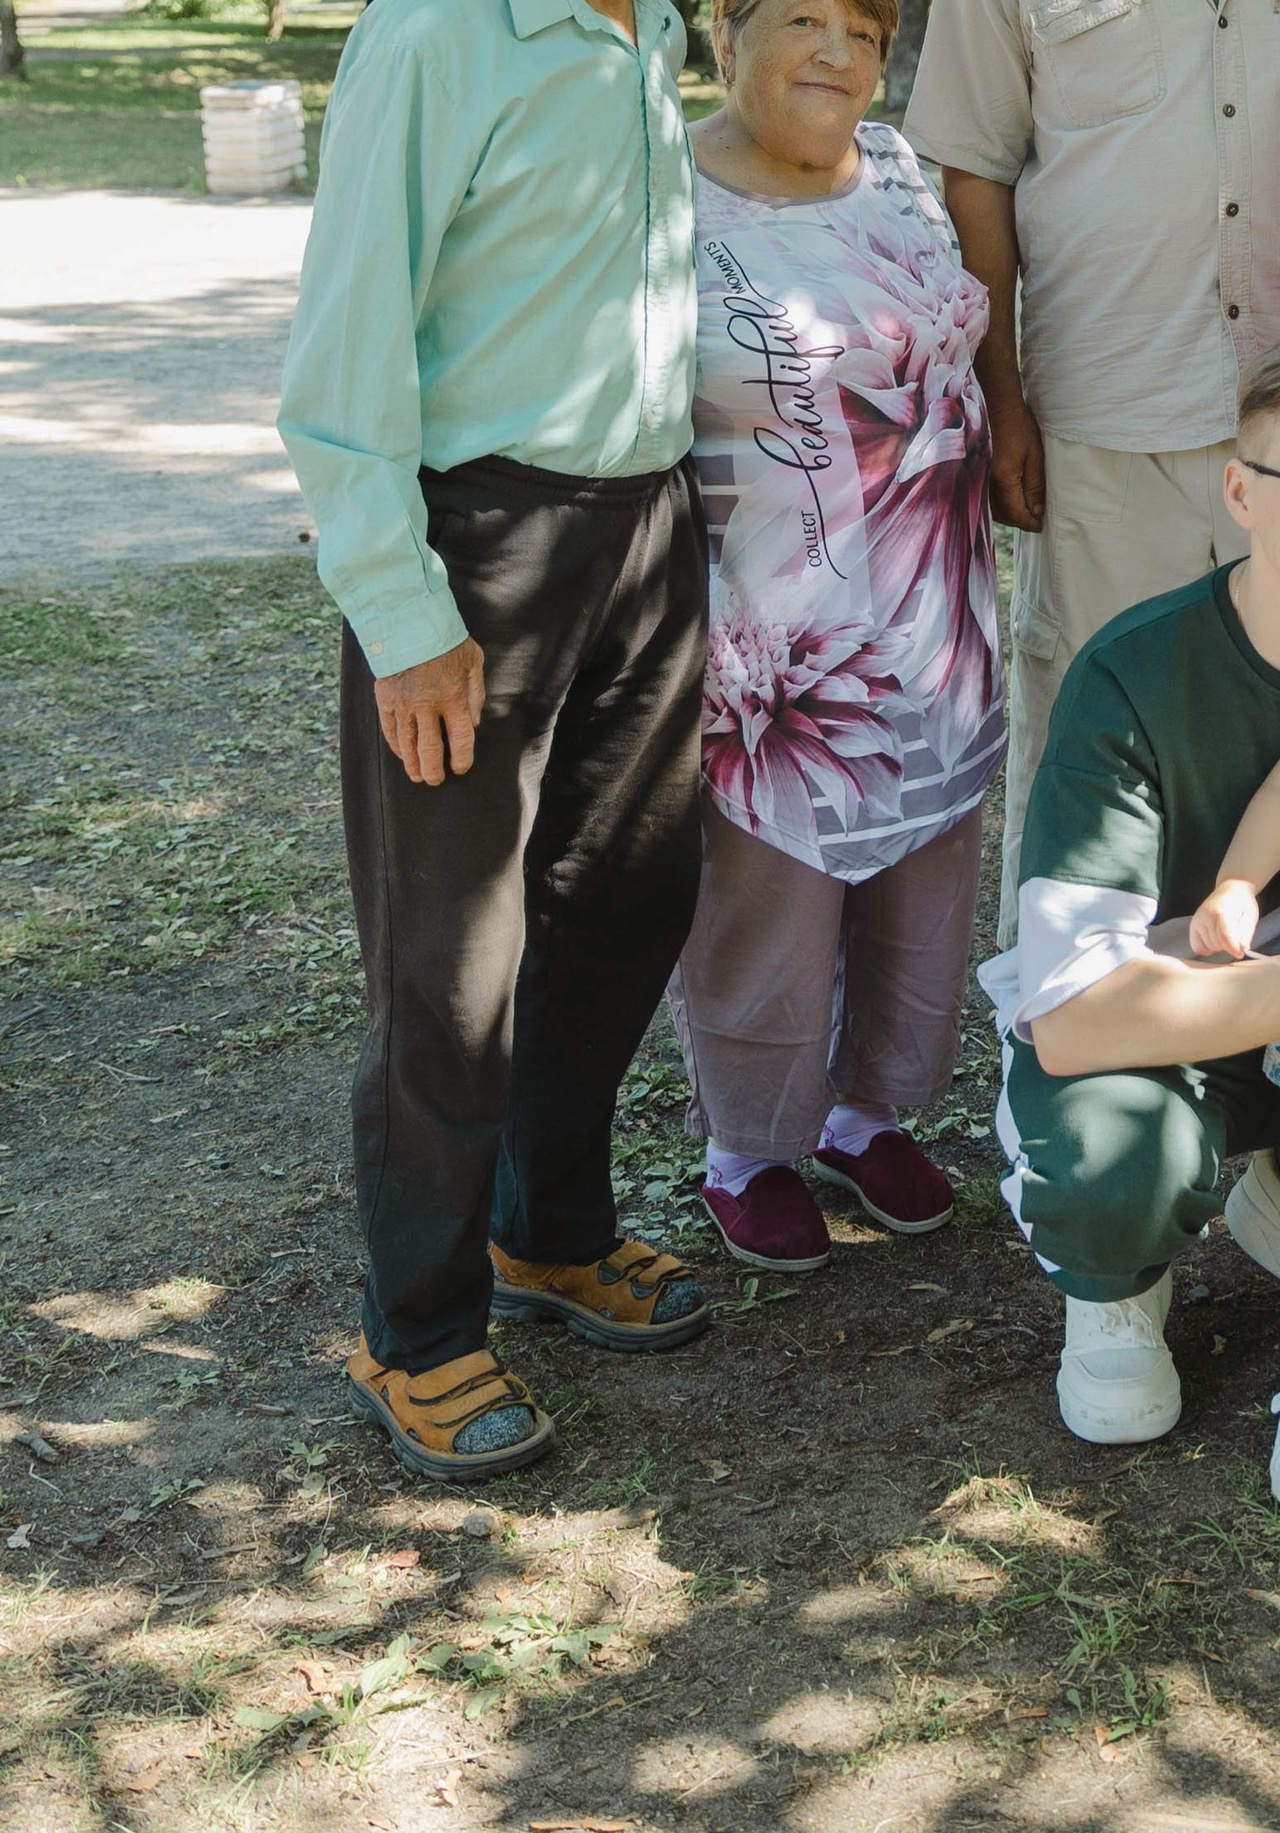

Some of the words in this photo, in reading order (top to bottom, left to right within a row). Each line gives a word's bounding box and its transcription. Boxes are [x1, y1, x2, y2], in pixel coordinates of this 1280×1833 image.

[704, 241, 747, 294] MOMENTS
[722, 295, 847, 473] beautiful
[801, 510, 823, 568] COLLECT
